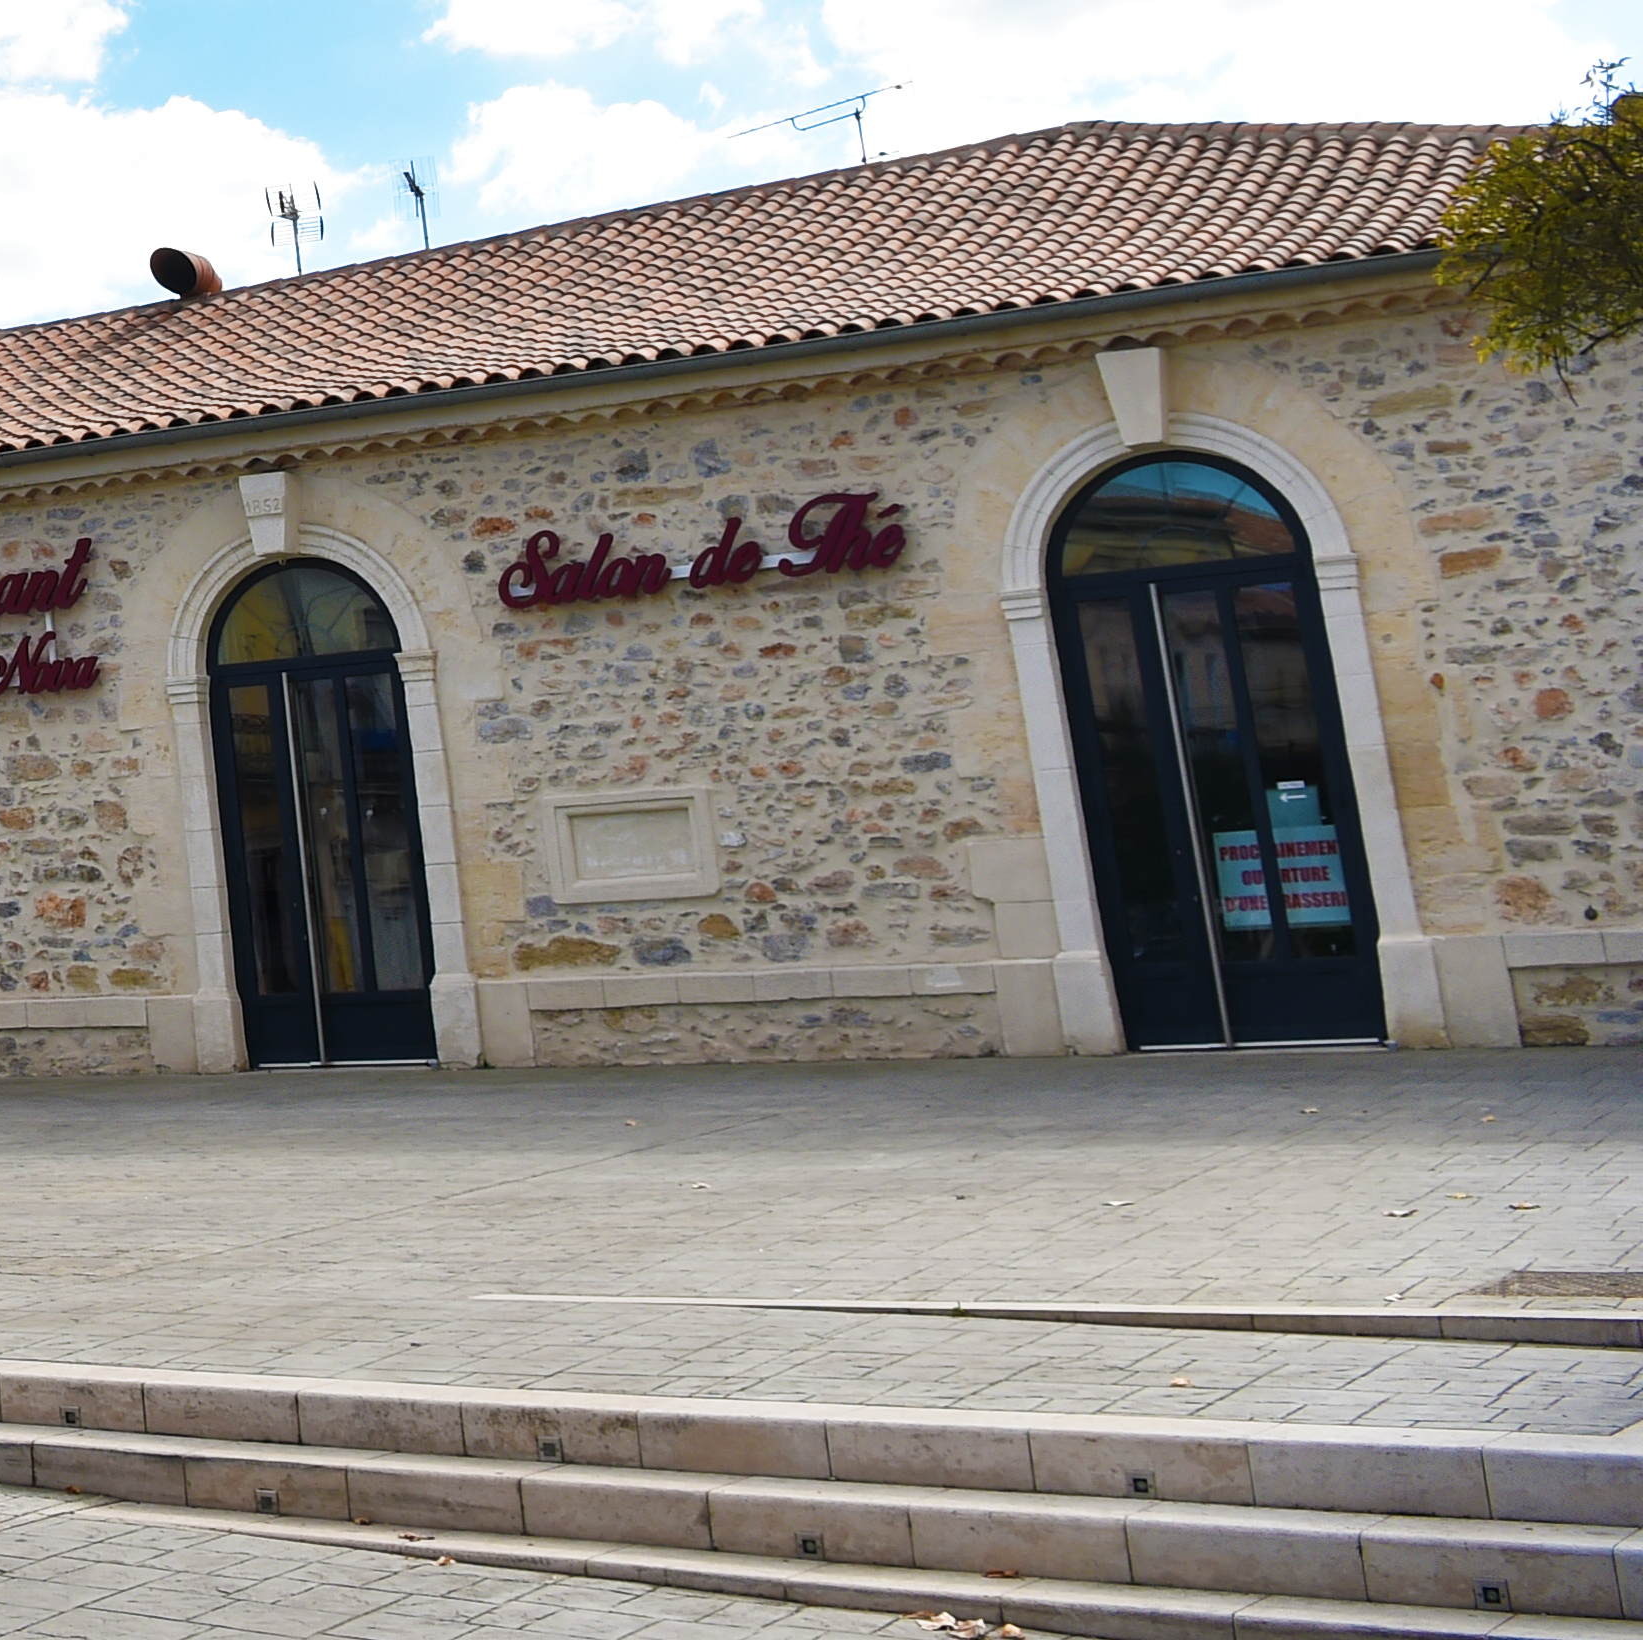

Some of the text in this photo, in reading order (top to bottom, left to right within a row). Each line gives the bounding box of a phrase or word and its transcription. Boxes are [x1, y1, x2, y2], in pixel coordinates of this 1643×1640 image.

[246, 498, 280, 514] 1852
[498, 491, 907, 609] Salon de Thé
[1241, 865, 1332, 886] OURTURE
[1282, 891, 1350, 910] RASSERI
